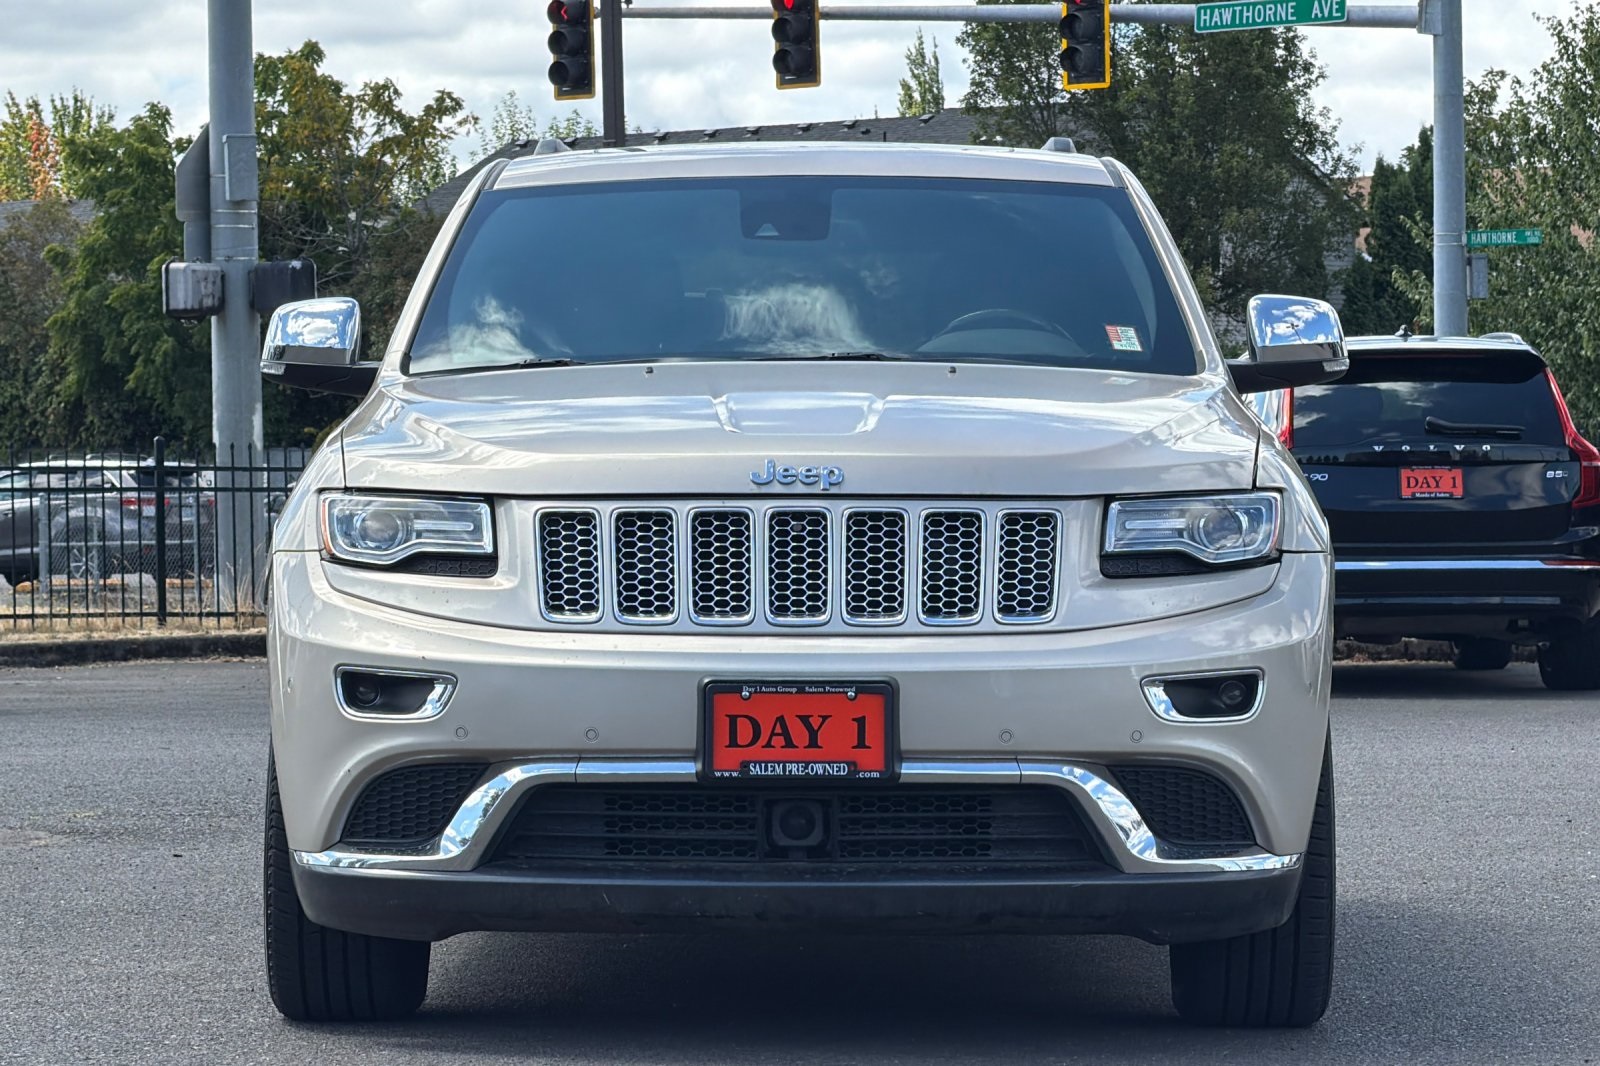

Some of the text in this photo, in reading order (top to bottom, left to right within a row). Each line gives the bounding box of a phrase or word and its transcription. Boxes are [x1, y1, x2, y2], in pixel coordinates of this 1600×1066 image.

[1200, 0, 1341, 27] HAWTHORNE AVE
[1471, 231, 1517, 244] HAWTHORNE
[749, 459, 844, 491] Jeep
[1304, 473, 1329, 481] 90
[1406, 475, 1458, 489] DAY 1
[725, 714, 872, 750] DAY 1
[749, 763, 783, 776] SALEM
[786, 763, 848, 776] PRE-OWNED
[856, 770, 880, 778] .com
